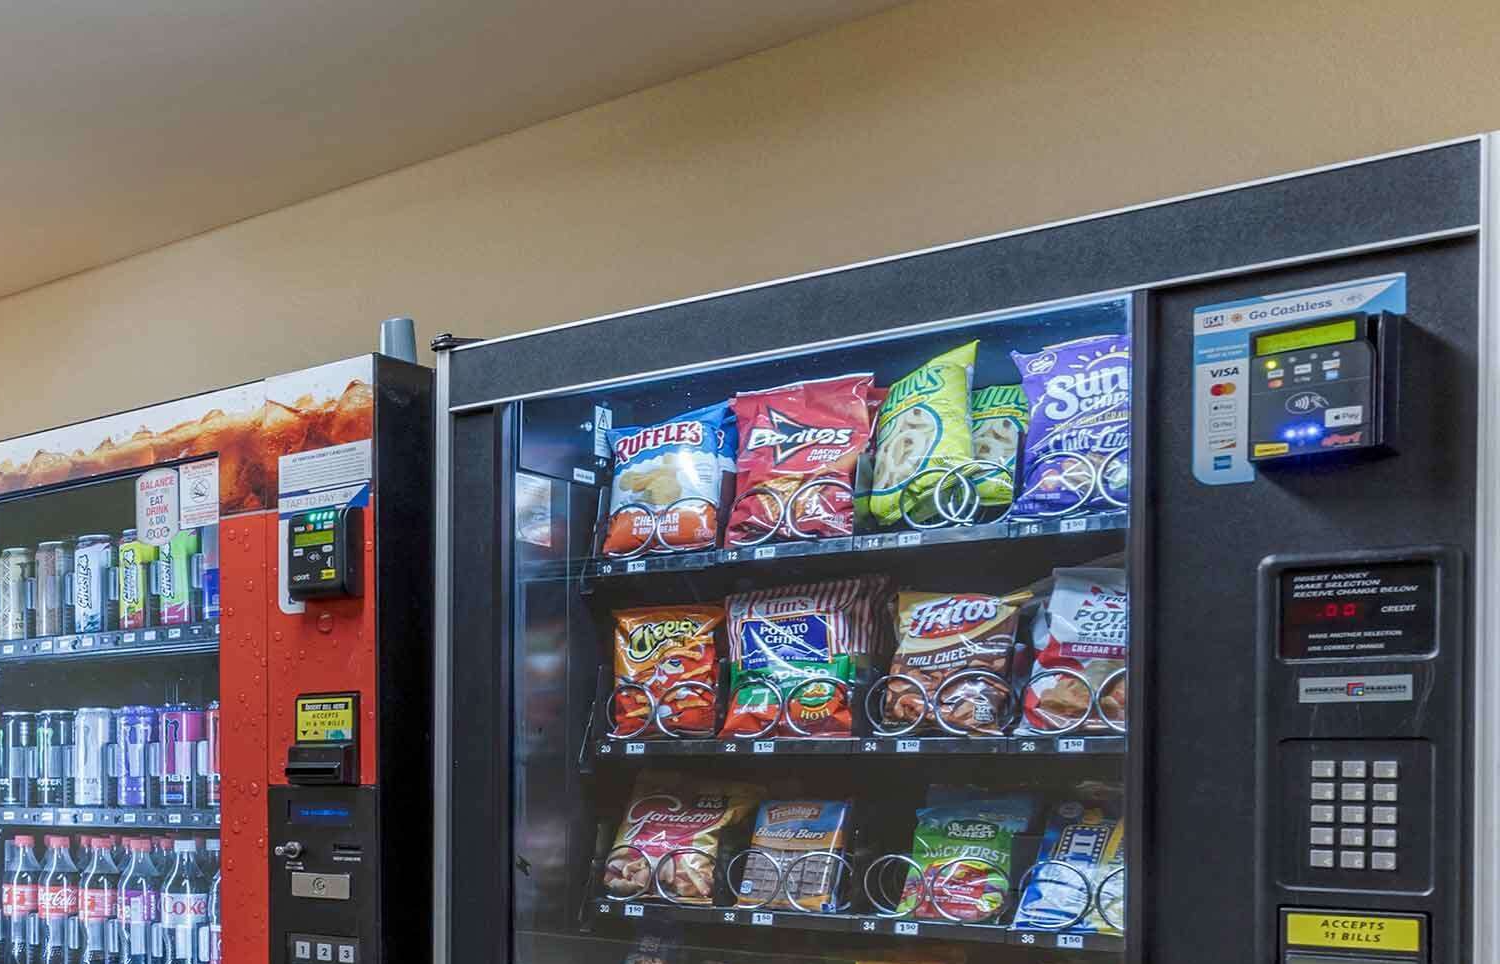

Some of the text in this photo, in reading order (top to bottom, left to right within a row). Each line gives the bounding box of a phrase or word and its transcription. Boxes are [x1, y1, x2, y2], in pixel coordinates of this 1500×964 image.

[1249, 299, 1333, 321] Go Cashless
[1209, 366, 1240, 379] VISA
[1046, 367, 1127, 420] Sun
[615, 421, 703, 464] RUFFLES
[747, 425, 854, 450] Doritos
[811, 448, 841, 458] NACHO
[140, 475, 175, 492] BALANCE
[150, 495, 164, 506] EAT
[146, 504, 169, 517] DRINK
[867, 538, 879, 547] 14
[727, 552, 737, 560] 12
[602, 565, 611, 574] 10
[1332, 571, 1369, 580] MONEY
[1294, 579, 1381, 590] MAKE SELECTION
[1293, 584, 1419, 598] RECEIVE CHANGE BELOW
[1381, 604, 1417, 613] CREDIT
[908, 596, 1000, 638] Fritos
[760, 623, 809, 635] POTATO
[907, 655, 932, 666] CHILI
[601, 745, 611, 753] 20
[726, 744, 736, 752] 22
[865, 742, 876, 751] 24
[1021, 742, 1035, 751] 26
[755, 827, 826, 840] Buddy Bars
[163, 894, 207, 916] Coke
[724, 912, 735, 921] 32
[863, 922, 875, 931] 34
[1321, 919, 1385, 931] ACCEPTS
[1341, 932, 1381, 942] BILLS
[322, 947, 328, 957] 2
[344, 950, 350, 959] 3
